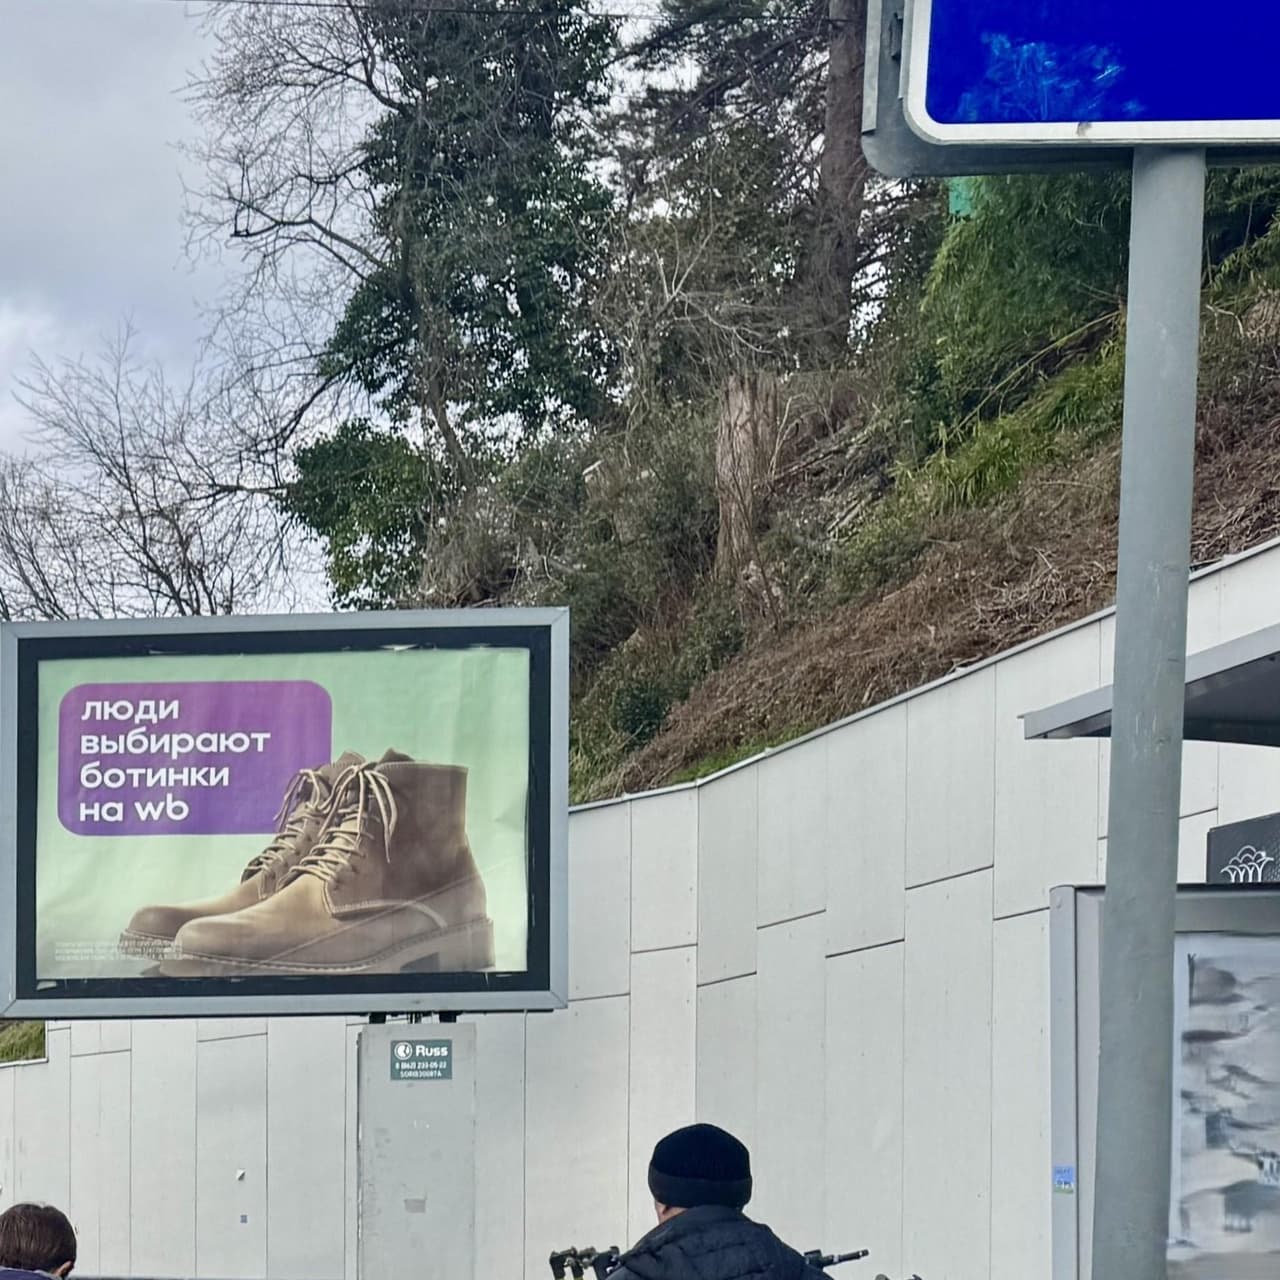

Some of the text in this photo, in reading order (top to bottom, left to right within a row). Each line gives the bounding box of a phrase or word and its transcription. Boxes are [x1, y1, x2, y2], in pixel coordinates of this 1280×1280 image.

[81, 699, 180, 724] люди
[80, 726, 271, 760] выбирают
[80, 763, 229, 789] ботинки
[79, 794, 189, 823] на wb
[415, 1044, 449, 1057] Russ
